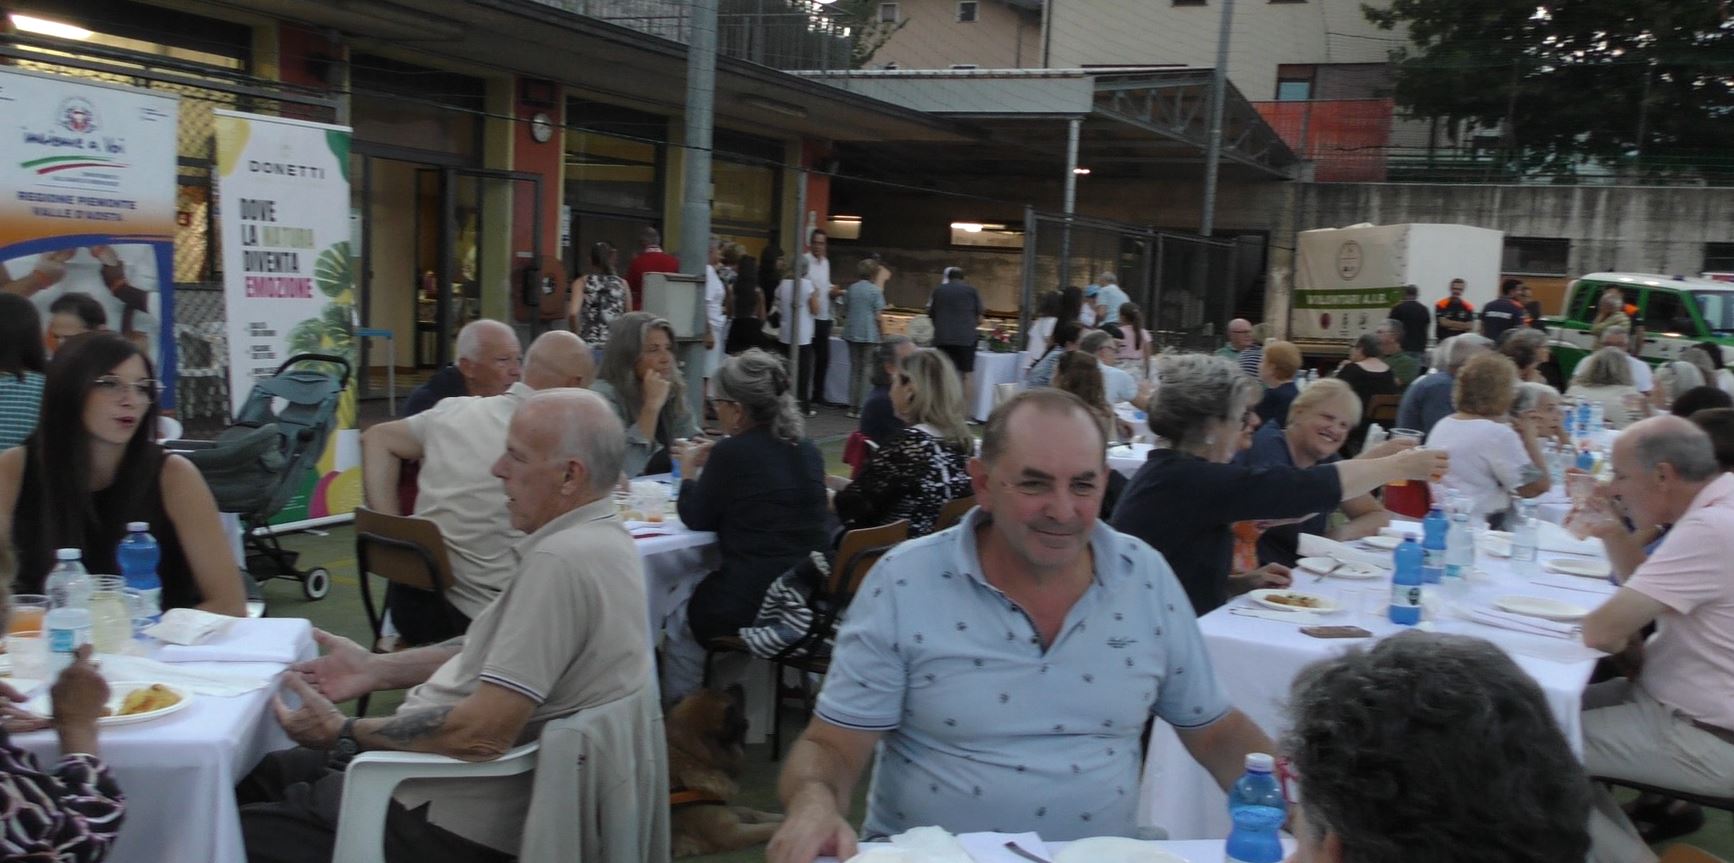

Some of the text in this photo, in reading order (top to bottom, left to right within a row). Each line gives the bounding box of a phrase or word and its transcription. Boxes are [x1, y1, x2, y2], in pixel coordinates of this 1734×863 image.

[249, 160, 325, 179] DONETTI
[17, 191, 137, 210] REGIONE PIEMONTE
[240, 198, 276, 222] DOVE
[32, 206, 71, 219] VALLE
[241, 224, 315, 250] LA NATURA
[243, 250, 300, 274] DIVENTA
[245, 276, 314, 299] EMOZIONE
